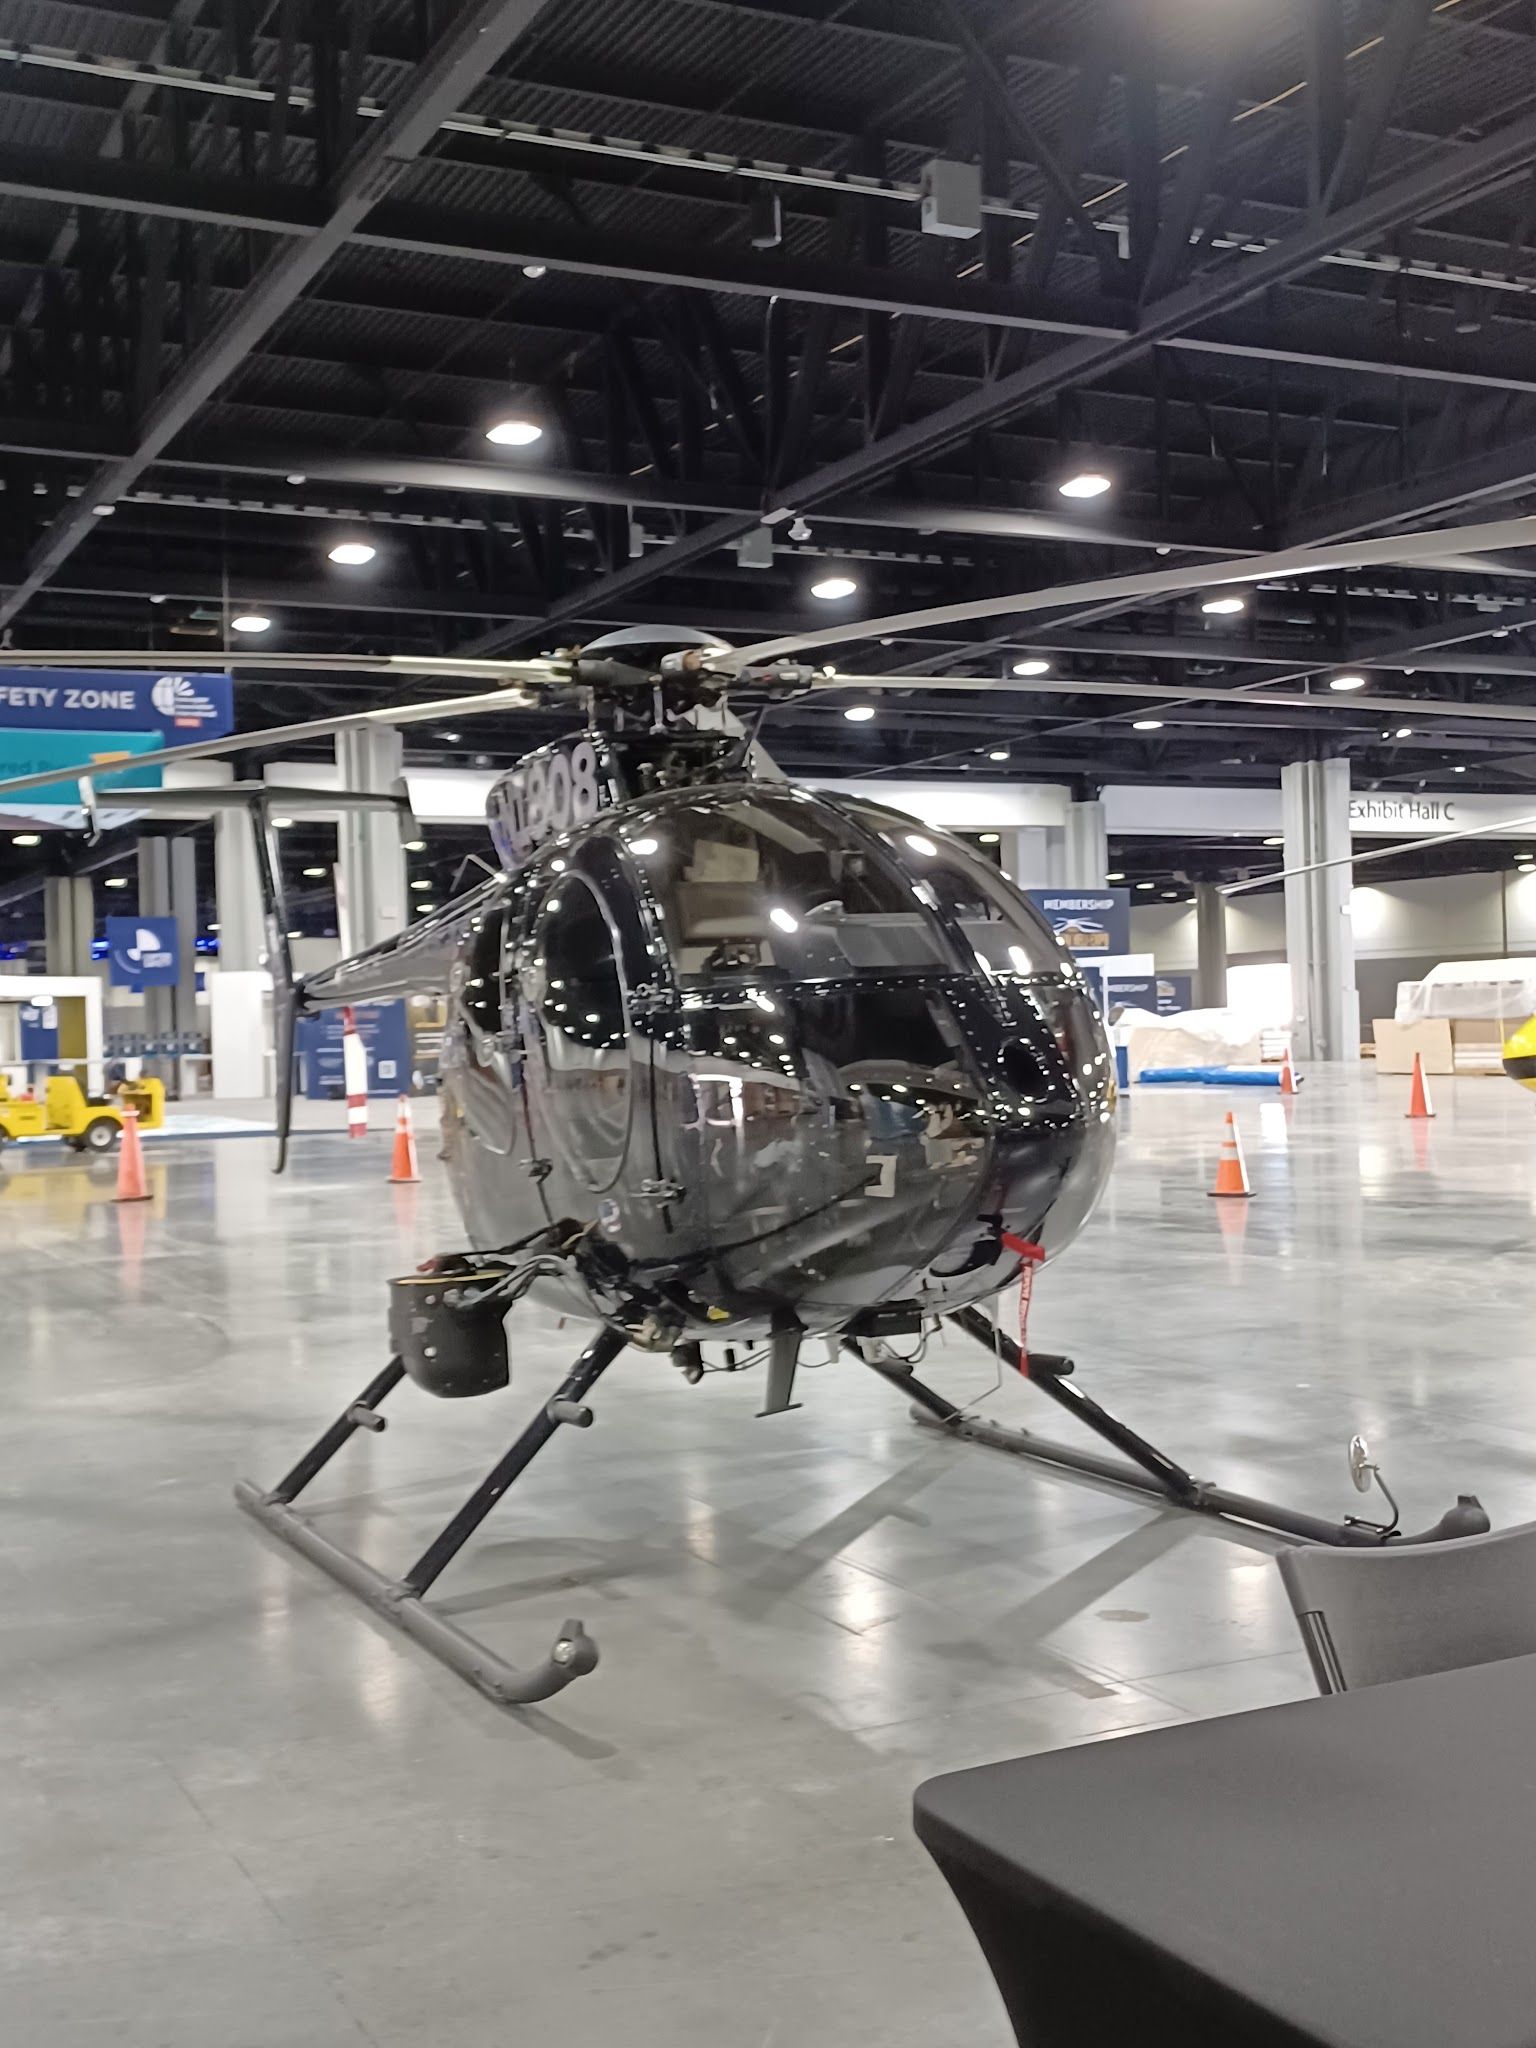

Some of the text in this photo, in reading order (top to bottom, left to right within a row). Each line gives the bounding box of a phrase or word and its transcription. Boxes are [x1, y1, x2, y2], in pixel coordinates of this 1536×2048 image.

[63, 688, 136, 710] ZONE
[1349, 800, 1456, 820] Exhibit Hall C
